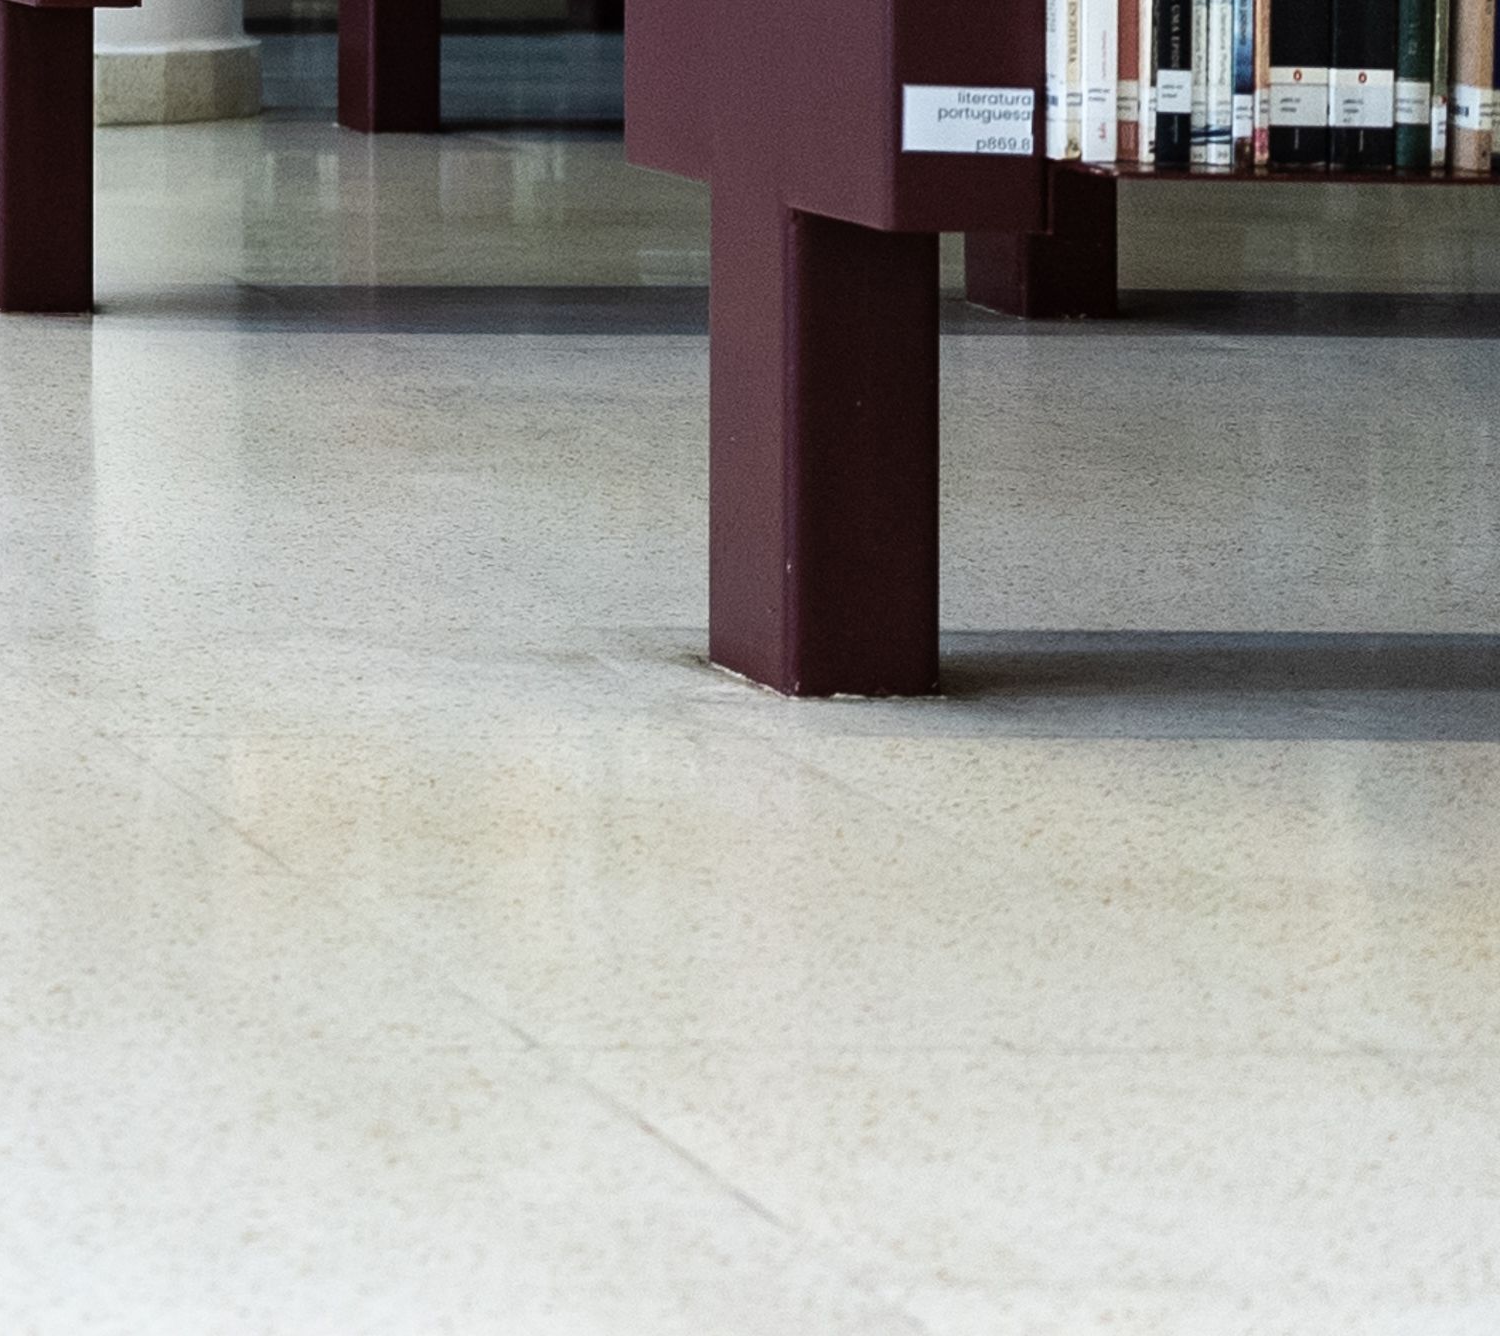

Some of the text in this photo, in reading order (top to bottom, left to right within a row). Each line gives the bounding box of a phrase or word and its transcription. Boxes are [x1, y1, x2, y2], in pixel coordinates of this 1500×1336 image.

[958, 92, 1031, 105] literatura
[938, 108, 1031, 124] portuguesa
[976, 137, 1031, 153] p869.8
